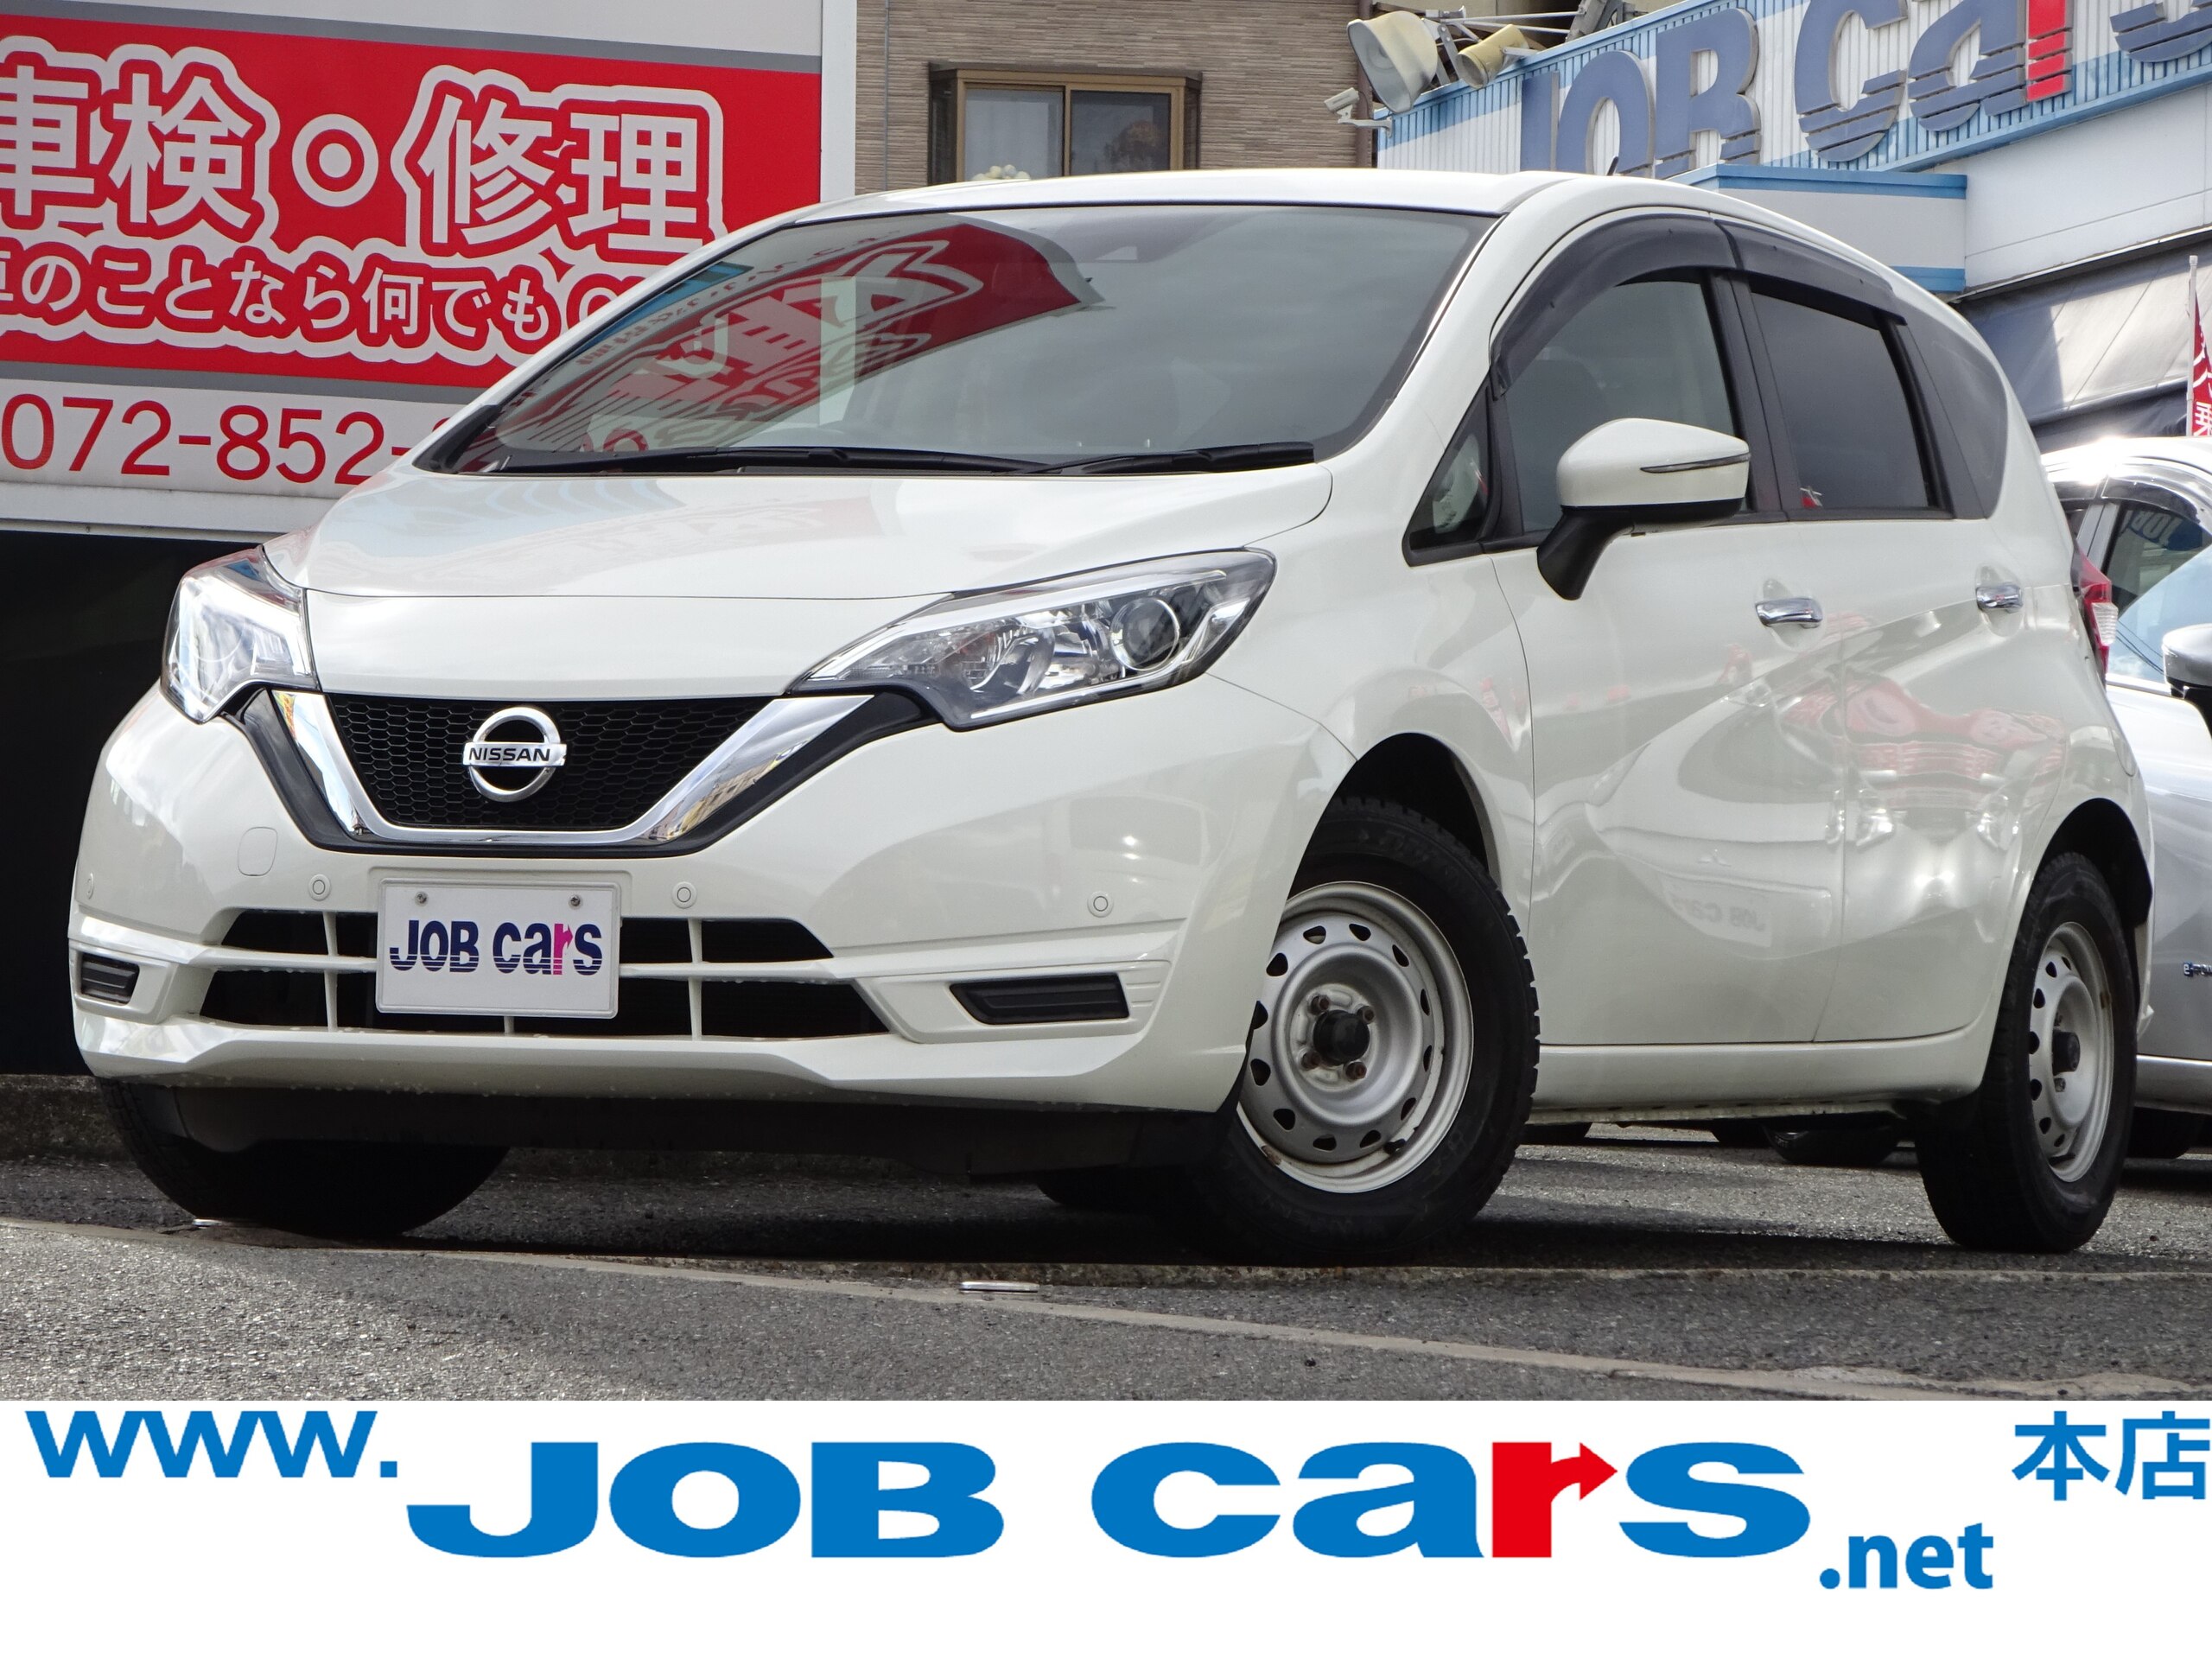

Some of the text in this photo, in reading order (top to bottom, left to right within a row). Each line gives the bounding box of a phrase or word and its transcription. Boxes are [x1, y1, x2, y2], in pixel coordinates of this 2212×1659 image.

[2, 394, 450, 485] 072-852-
[469, 747, 550, 761] NISSAN
[389, 919, 602, 976] JOB cars
